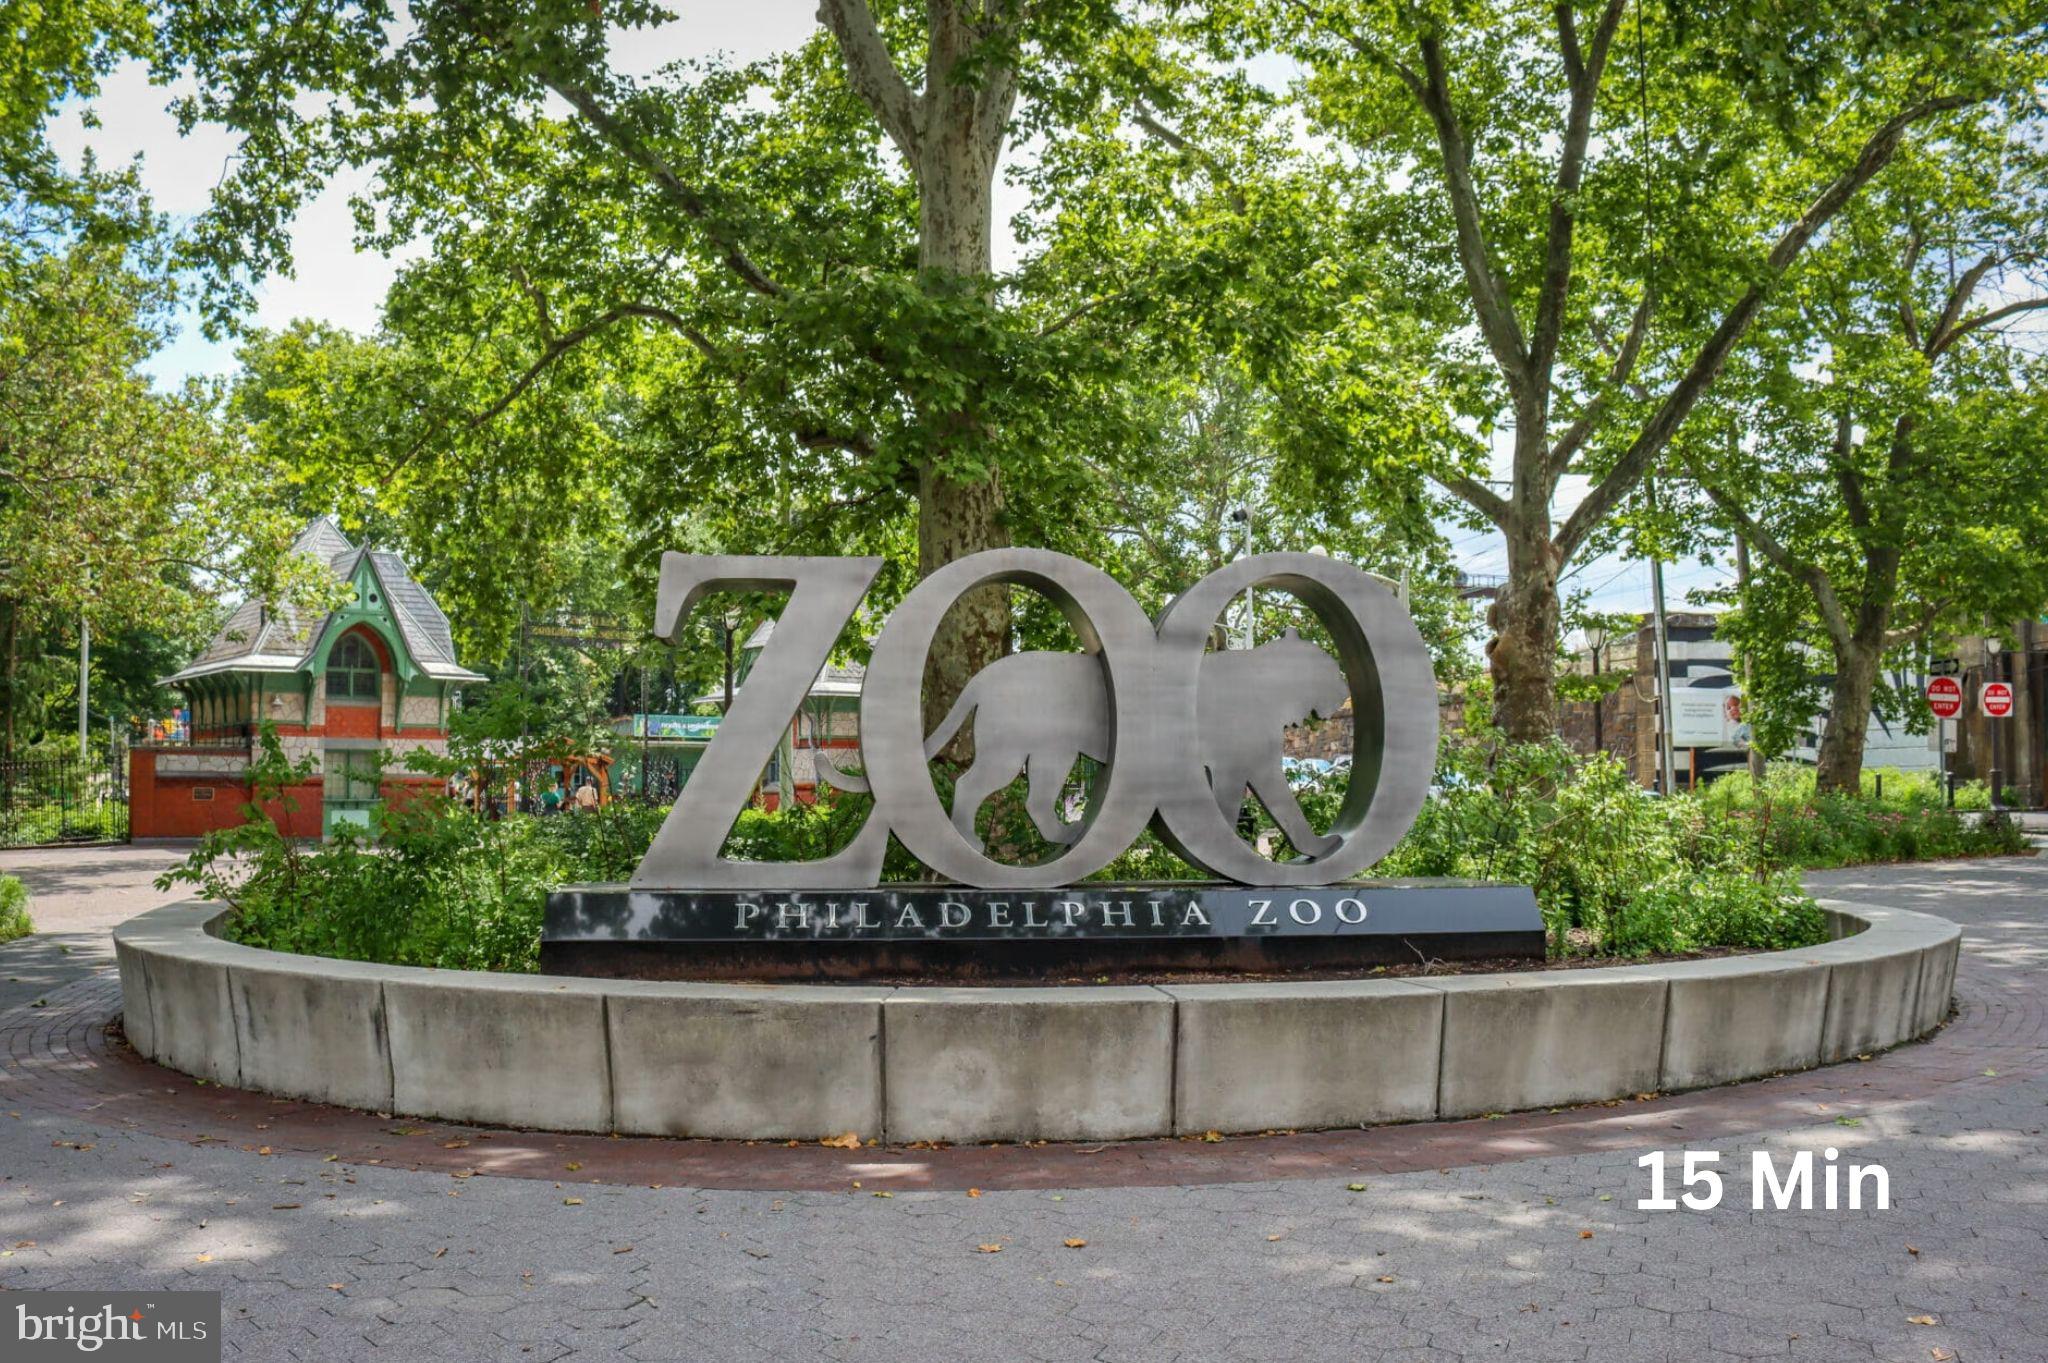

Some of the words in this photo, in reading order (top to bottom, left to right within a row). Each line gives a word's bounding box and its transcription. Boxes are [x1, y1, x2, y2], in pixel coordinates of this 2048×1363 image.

[631, 549, 1438, 890] ZOO
[735, 901, 1210, 929] PHILADELPHIA
[1248, 898, 1368, 925] ZOO
